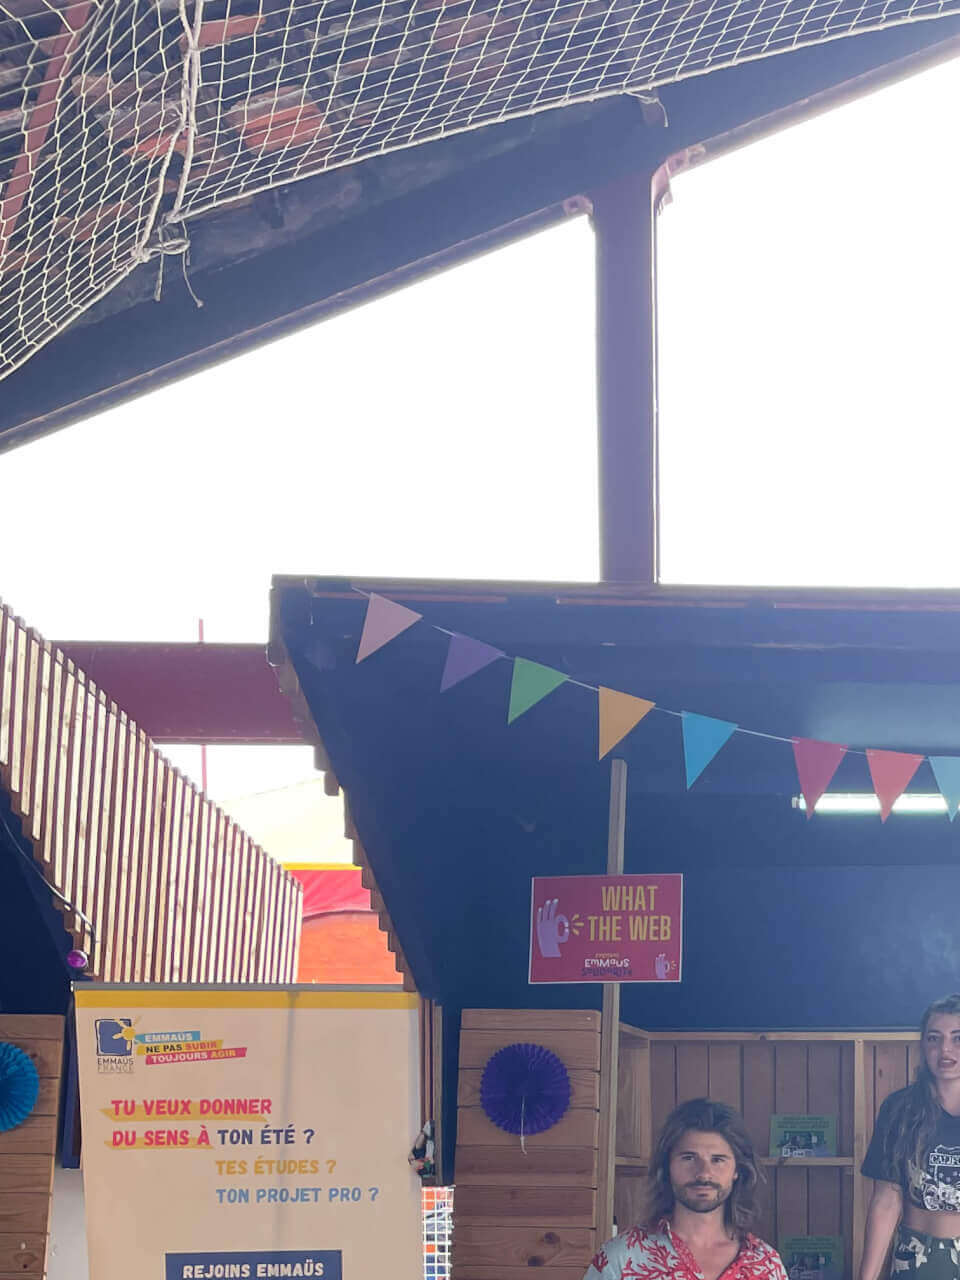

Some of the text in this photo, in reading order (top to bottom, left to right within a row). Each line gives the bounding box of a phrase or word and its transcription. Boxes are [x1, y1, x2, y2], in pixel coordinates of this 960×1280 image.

[602, 886, 658, 911] WHAT
[587, 915, 671, 941] THE WEB
[146, 1045, 160, 1053] NE
[164, 1044, 182, 1052] PAS
[151, 1052, 208, 1063] TOUJOURS
[111, 1099, 272, 1116] TU VEUX DONNER
[112, 1124, 315, 1146] DU SENS À TON ÉTÉ ?
[215, 1156, 337, 1175] TES ÉTUDES ?
[216, 1187, 379, 1203] TON PROJET PRO ?
[183, 1258, 324, 1279] REJOINS EMMAÜS
